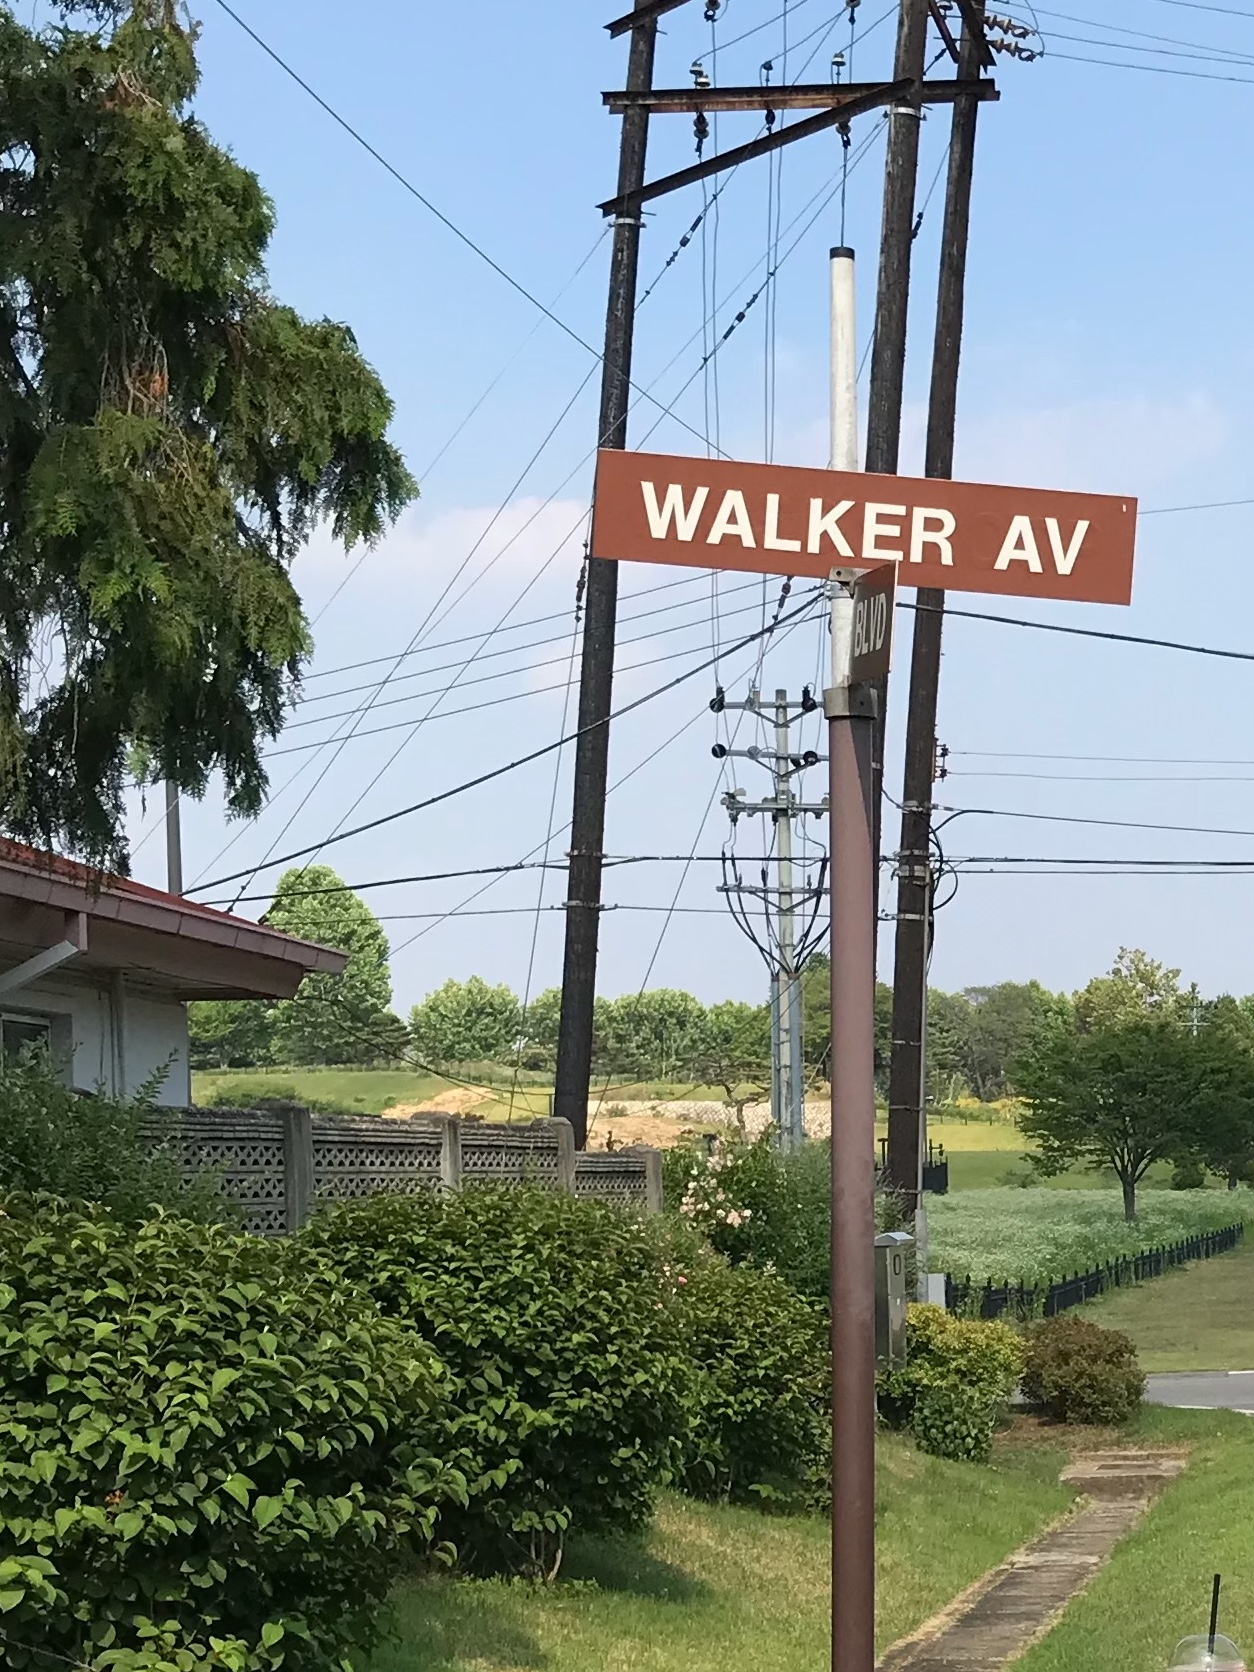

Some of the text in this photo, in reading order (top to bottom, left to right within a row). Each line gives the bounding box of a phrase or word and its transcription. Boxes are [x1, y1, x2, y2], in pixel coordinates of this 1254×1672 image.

[640, 480, 1091, 576] WALKER AV
[854, 592, 887, 658] BLVD
